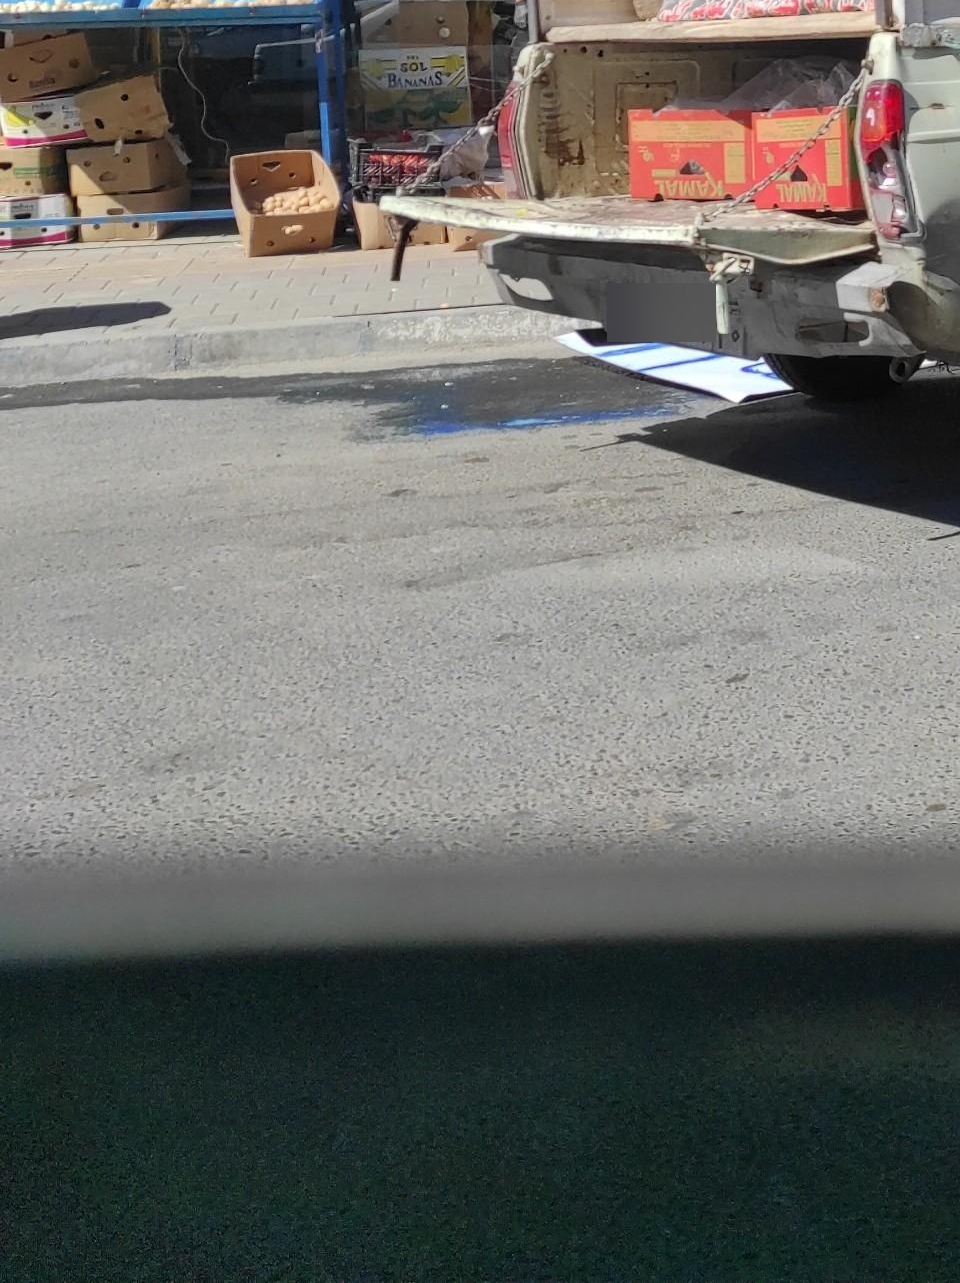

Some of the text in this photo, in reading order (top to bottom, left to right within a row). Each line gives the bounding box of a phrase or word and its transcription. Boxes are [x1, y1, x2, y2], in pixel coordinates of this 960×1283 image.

[400, 62, 428, 73] SOL
[387, 70, 443, 89] BANANAS
[653, 172, 724, 197] KAMAL
[775, 174, 828, 203] KAMAL
